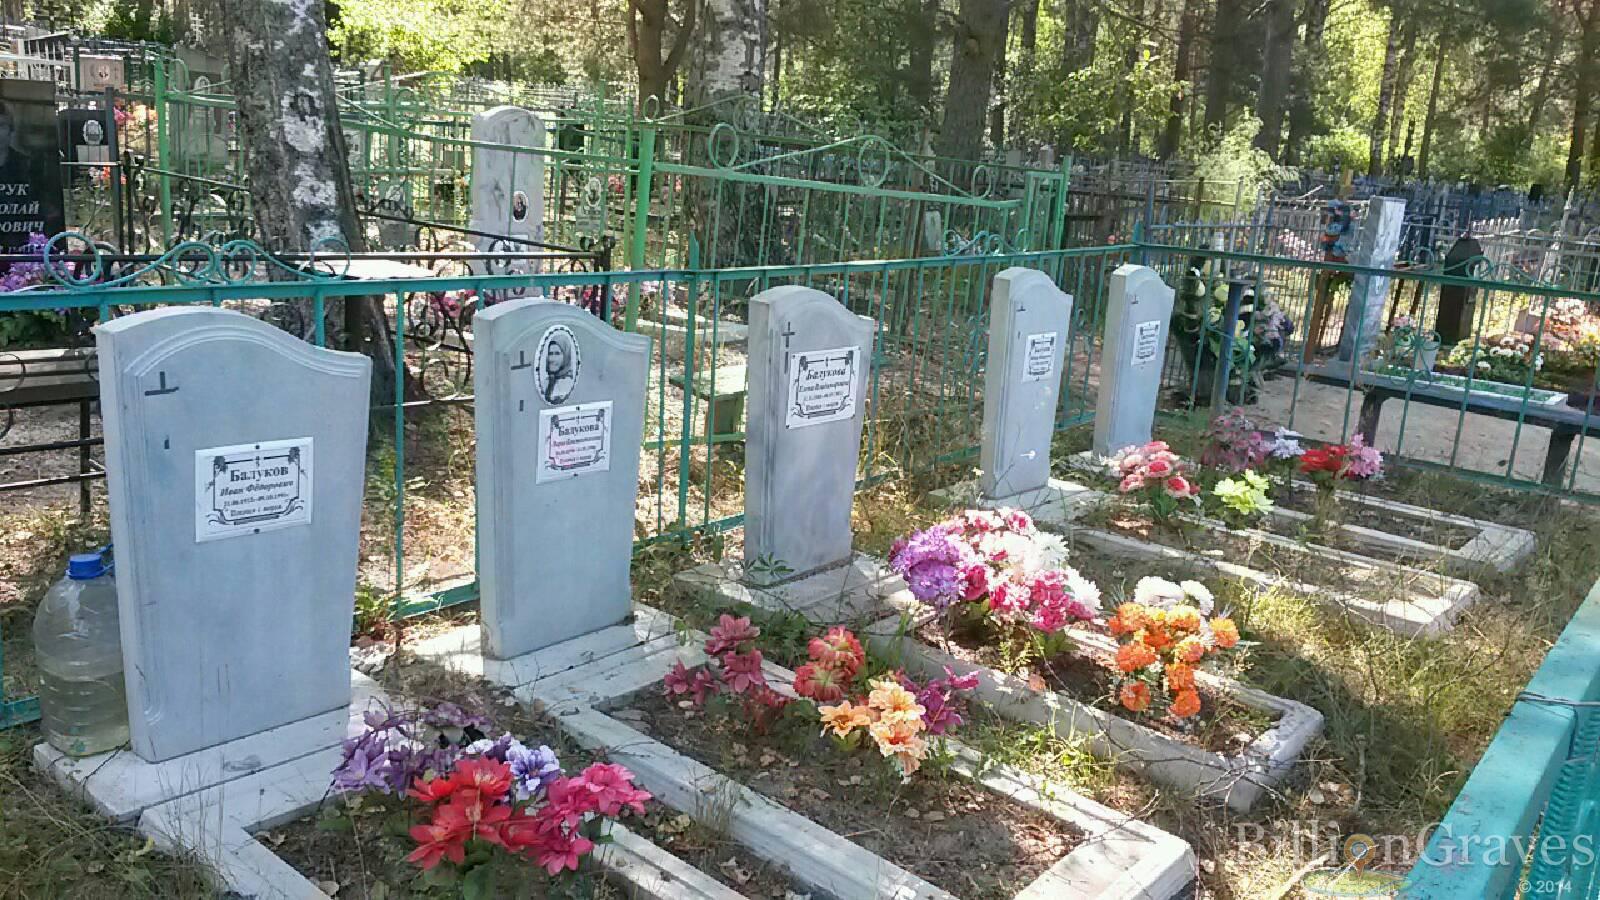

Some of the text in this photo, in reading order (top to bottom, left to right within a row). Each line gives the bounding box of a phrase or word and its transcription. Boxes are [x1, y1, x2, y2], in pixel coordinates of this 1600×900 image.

[0, 221, 45, 233] ОВИЧ
[559, 424, 600, 437] Балукова
[230, 466, 289, 482] Балуков
[220, 486, 243, 497] Иван
